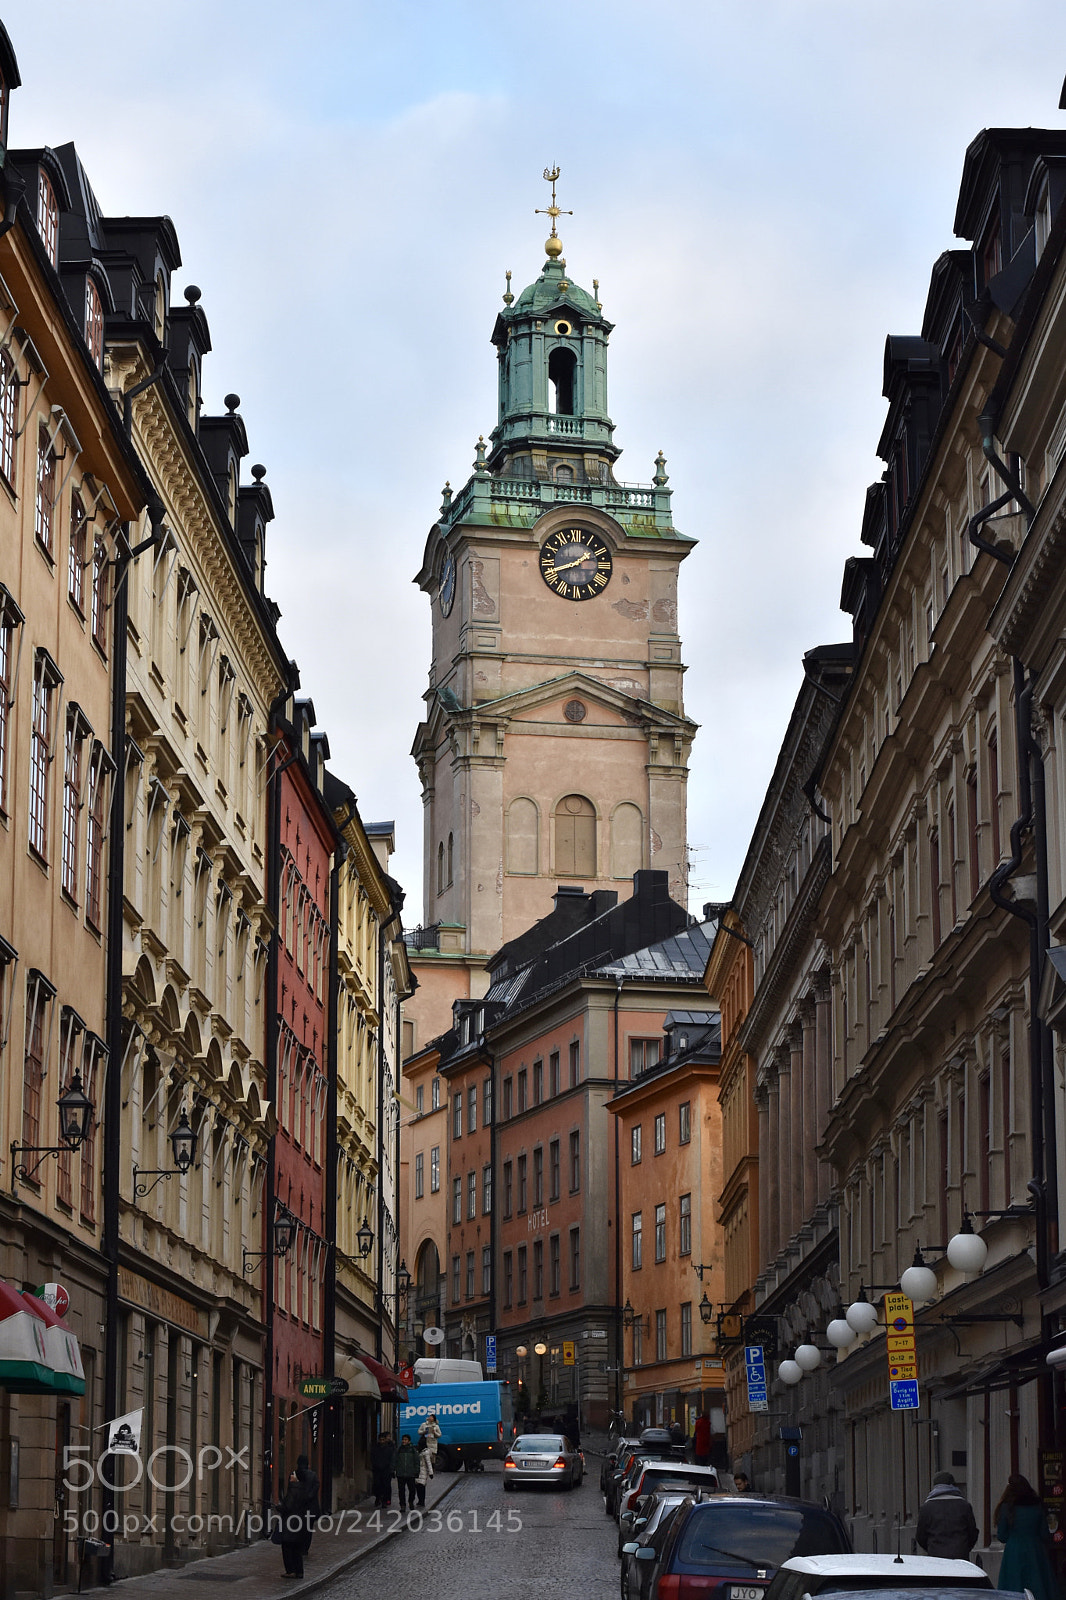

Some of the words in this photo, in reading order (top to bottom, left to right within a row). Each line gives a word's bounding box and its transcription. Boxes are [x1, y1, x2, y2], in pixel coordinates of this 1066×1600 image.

[555, 532, 568, 546] XI
[570, 530, 581, 542] XII
[545, 543, 558, 554] X
[528, 1208, 550, 1232] HOTEL
[889, 1304, 909, 1312] plats
[489, 1338, 494, 1346] P
[750, 1348, 760, 1363] P
[304, 1384, 326, 1394] ANTIK
[406, 1401, 480, 1419] postnord
[733, 1588, 757, 1599] JYO
